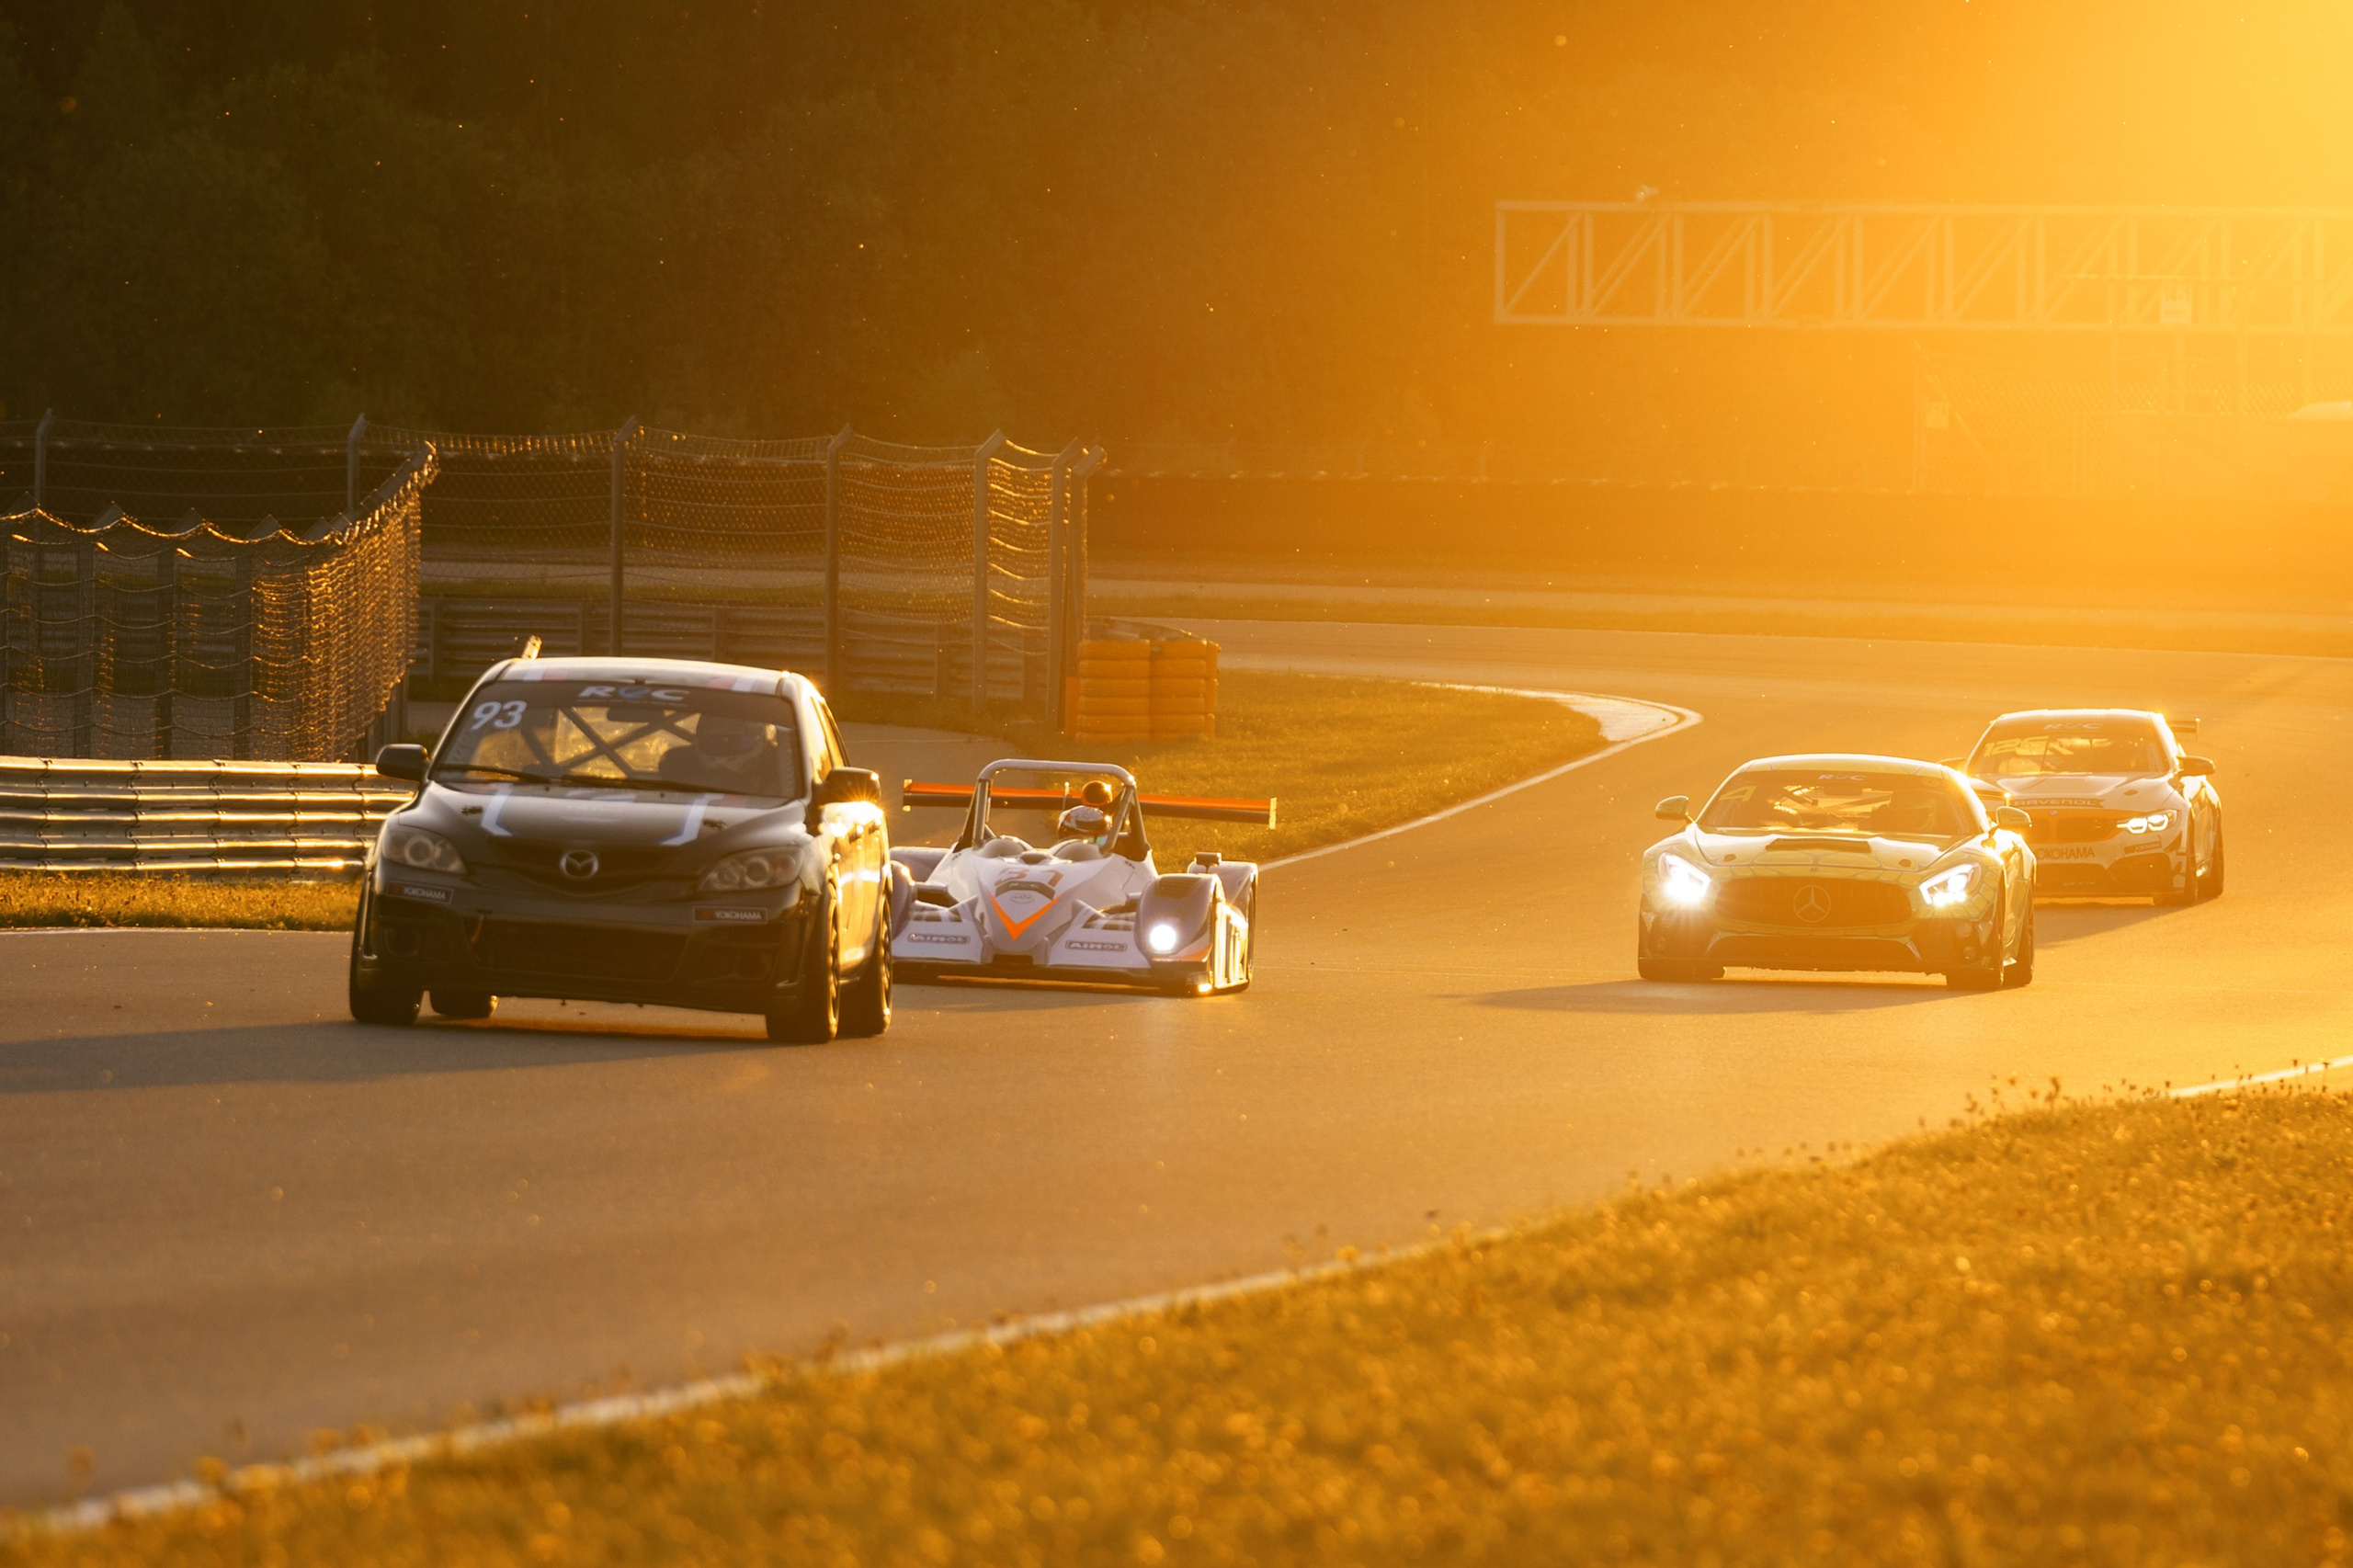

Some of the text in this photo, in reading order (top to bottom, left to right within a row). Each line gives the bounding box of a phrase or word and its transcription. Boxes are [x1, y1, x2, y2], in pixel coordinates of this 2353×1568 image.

[471, 700, 528, 730] 93
[404, 886, 446, 899] YOKOHAMA
[715, 911, 762, 920] YOKOHAMA
